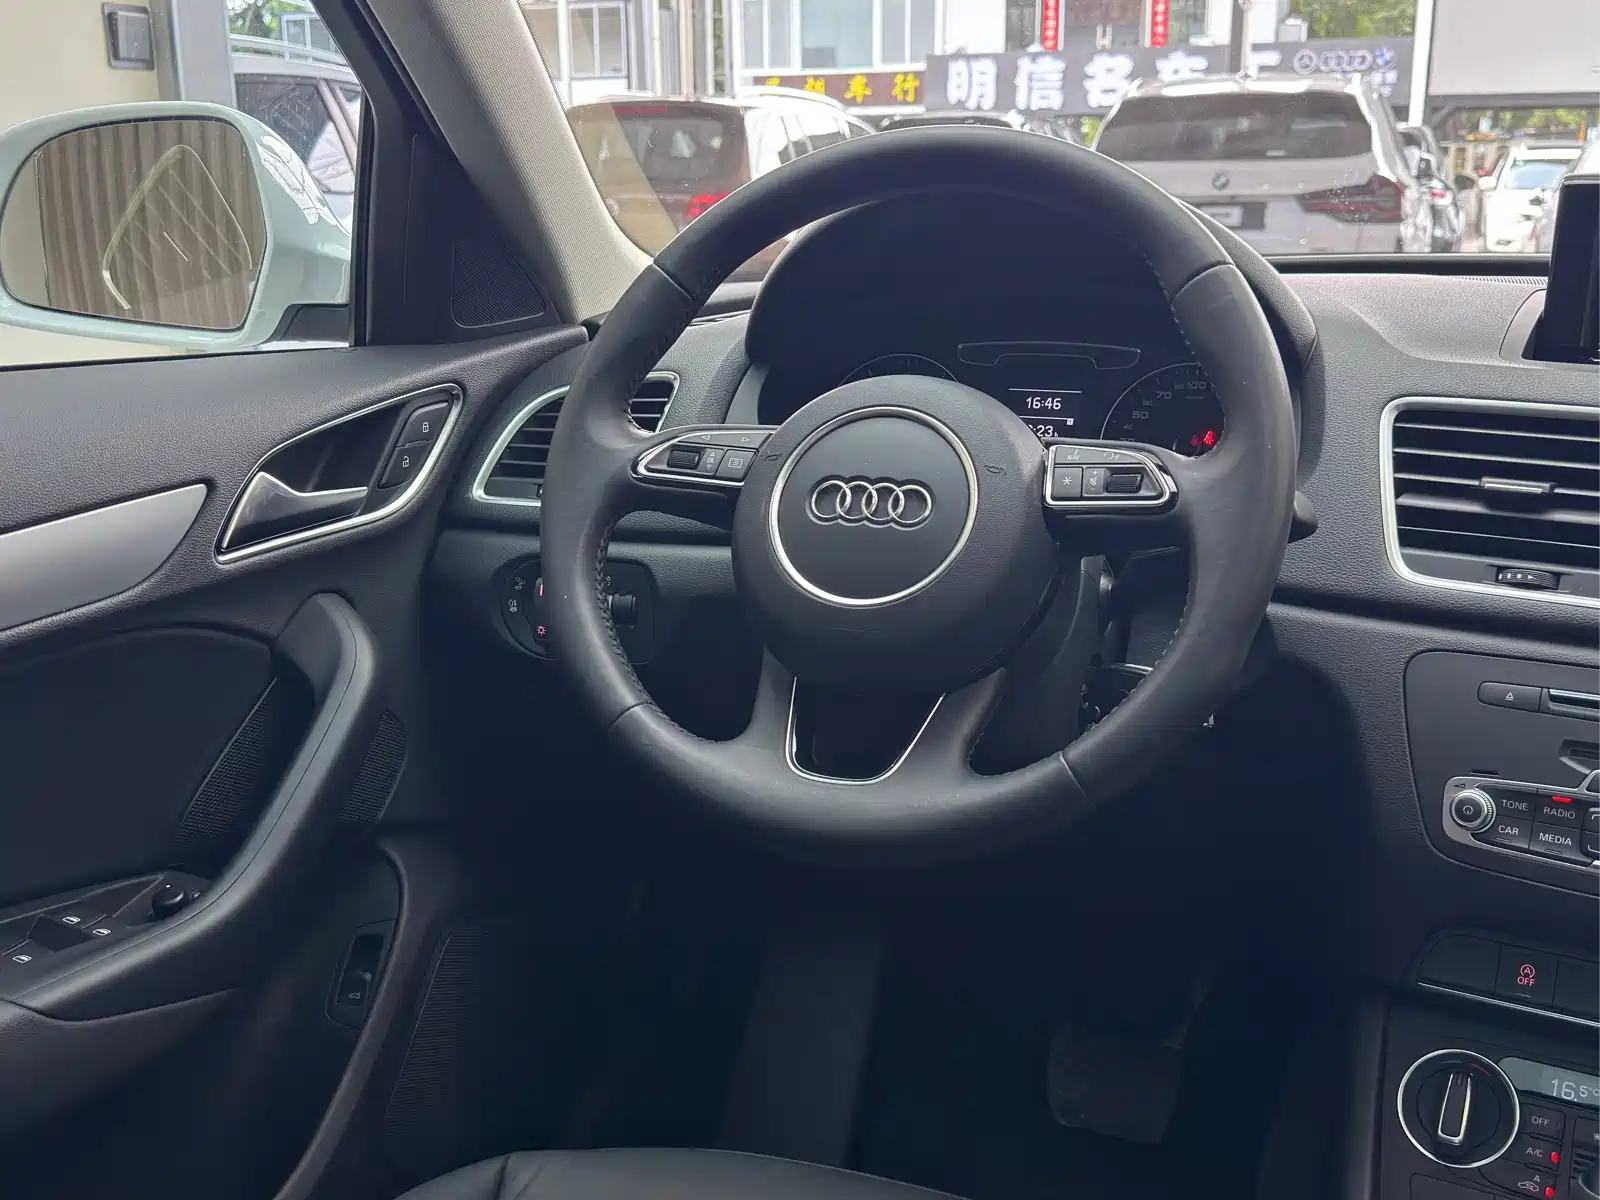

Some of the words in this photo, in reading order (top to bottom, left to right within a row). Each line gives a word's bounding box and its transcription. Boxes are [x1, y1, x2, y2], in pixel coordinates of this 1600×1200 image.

[1187, 381, 1207, 390] 100
[1155, 391, 1172, 400] 70
[1026, 396, 1062, 410] 16:46
[1132, 410, 1149, 419] 50
[1501, 799, 1528, 811] TONE
[1543, 806, 1575, 819] RADIO
[1498, 824, 1519, 836] CAR
[1539, 832, 1572, 846] MEDIA
[1517, 976, 1535, 987] OFF
[1531, 1115, 1550, 1127] OFF
[1525, 1146, 1544, 1158] A/C
[1533, 1174, 1541, 1183] A
